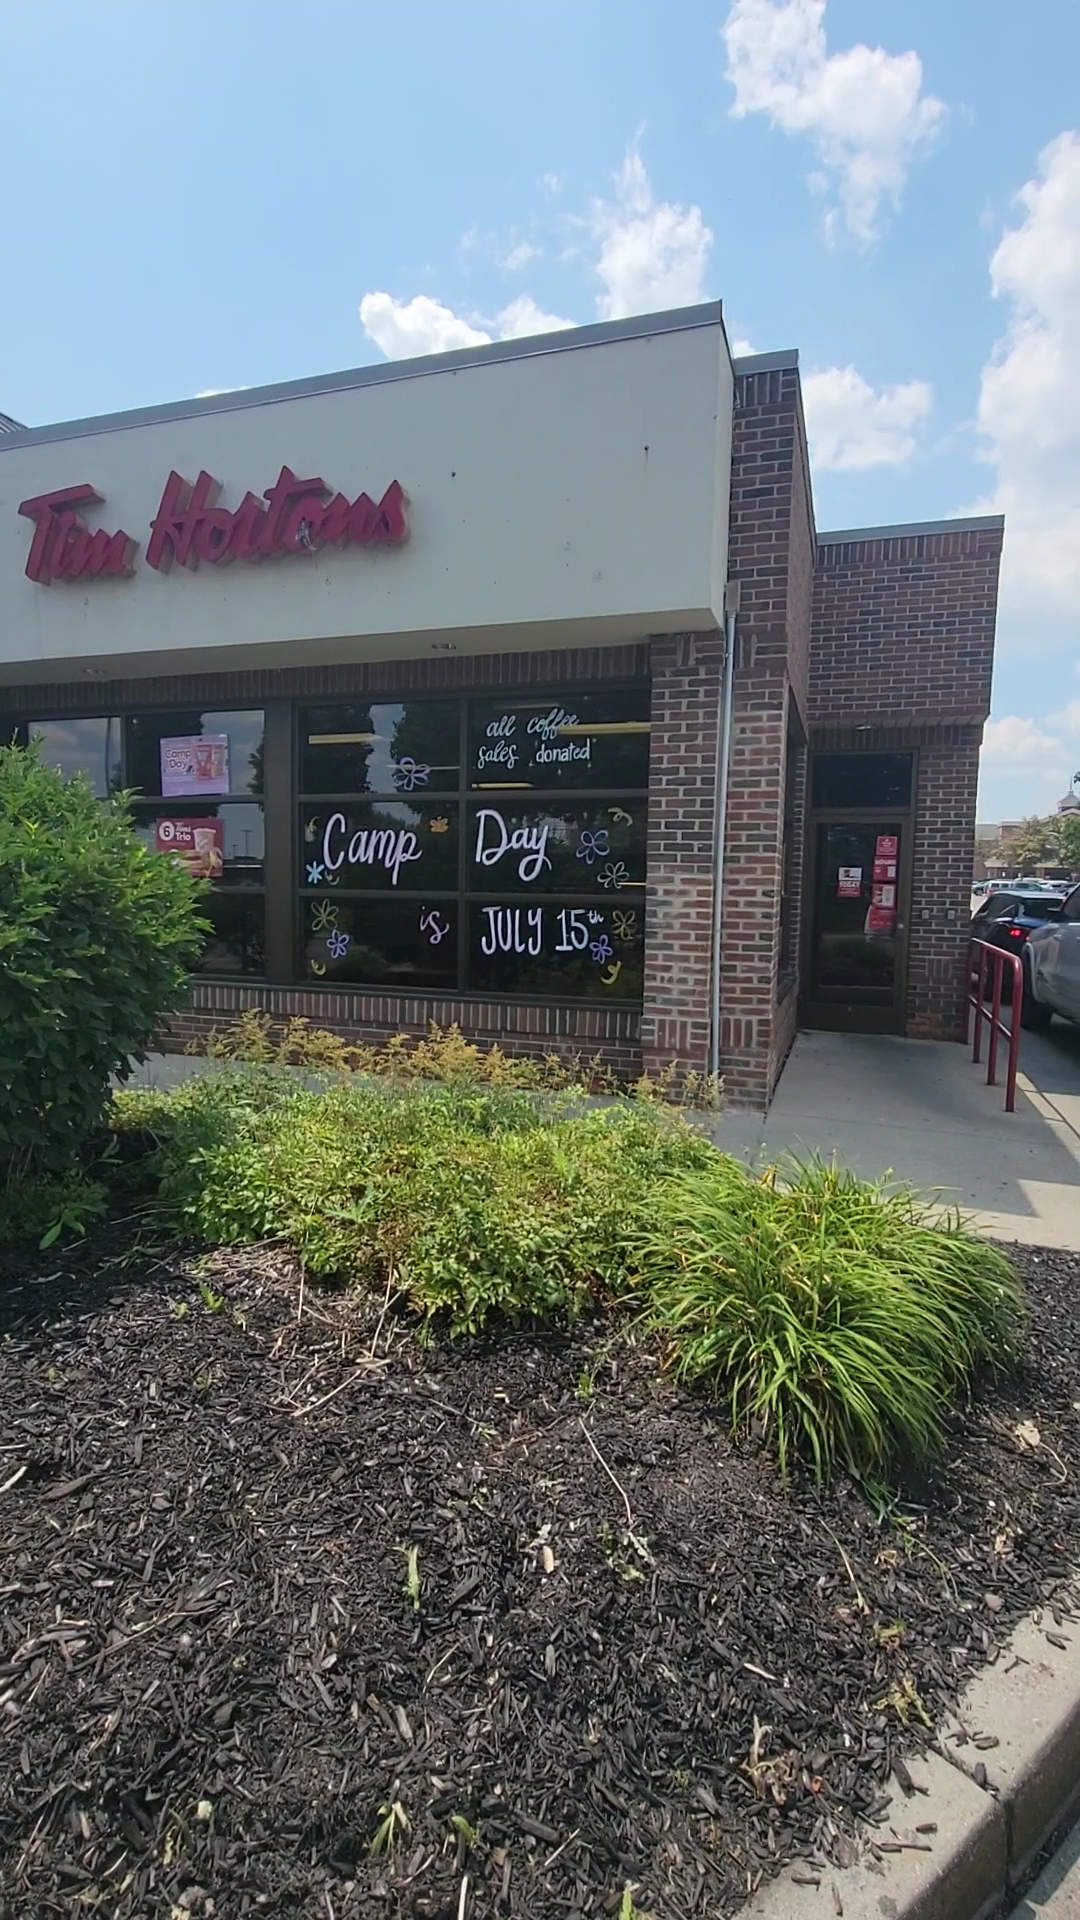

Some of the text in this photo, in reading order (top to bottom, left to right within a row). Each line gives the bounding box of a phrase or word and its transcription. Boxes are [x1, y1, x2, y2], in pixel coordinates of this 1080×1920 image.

[18, 465, 411, 586] Tim Hortons
[486, 708, 579, 740] all coffee
[165, 749, 191, 763] Camp
[169, 759, 187, 770] Day
[477, 737, 591, 769] sales donated
[175, 832, 191, 841] Trio
[322, 808, 552, 885] Camp Day
[419, 906, 450, 944] is
[481, 906, 543, 956] JULY
